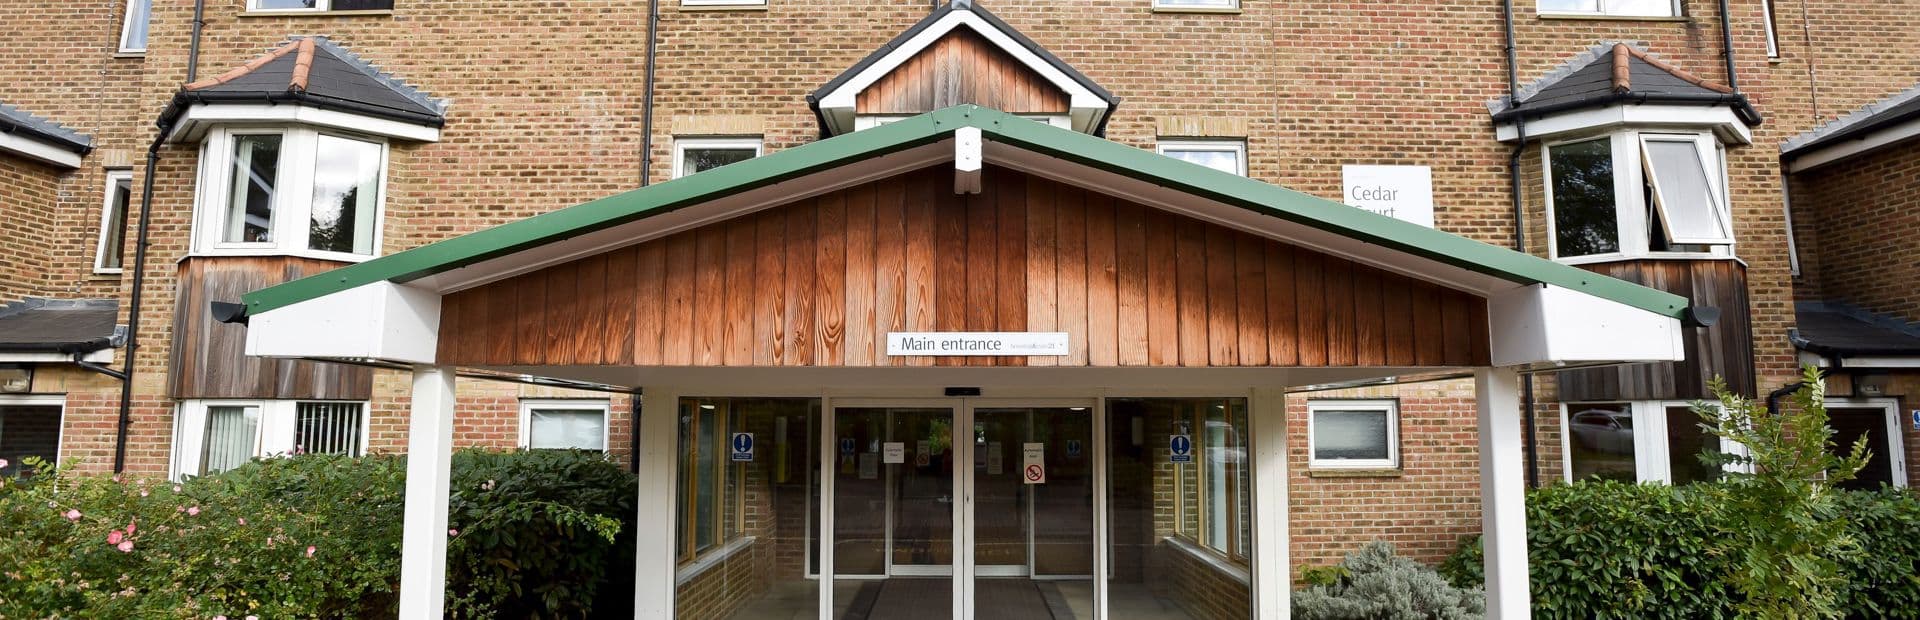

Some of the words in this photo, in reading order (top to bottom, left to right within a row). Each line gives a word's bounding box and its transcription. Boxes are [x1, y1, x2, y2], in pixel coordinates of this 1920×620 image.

[1352, 185, 1398, 201] Cedar
[901, 336, 936, 351] Main
[941, 338, 1002, 351] entrance
